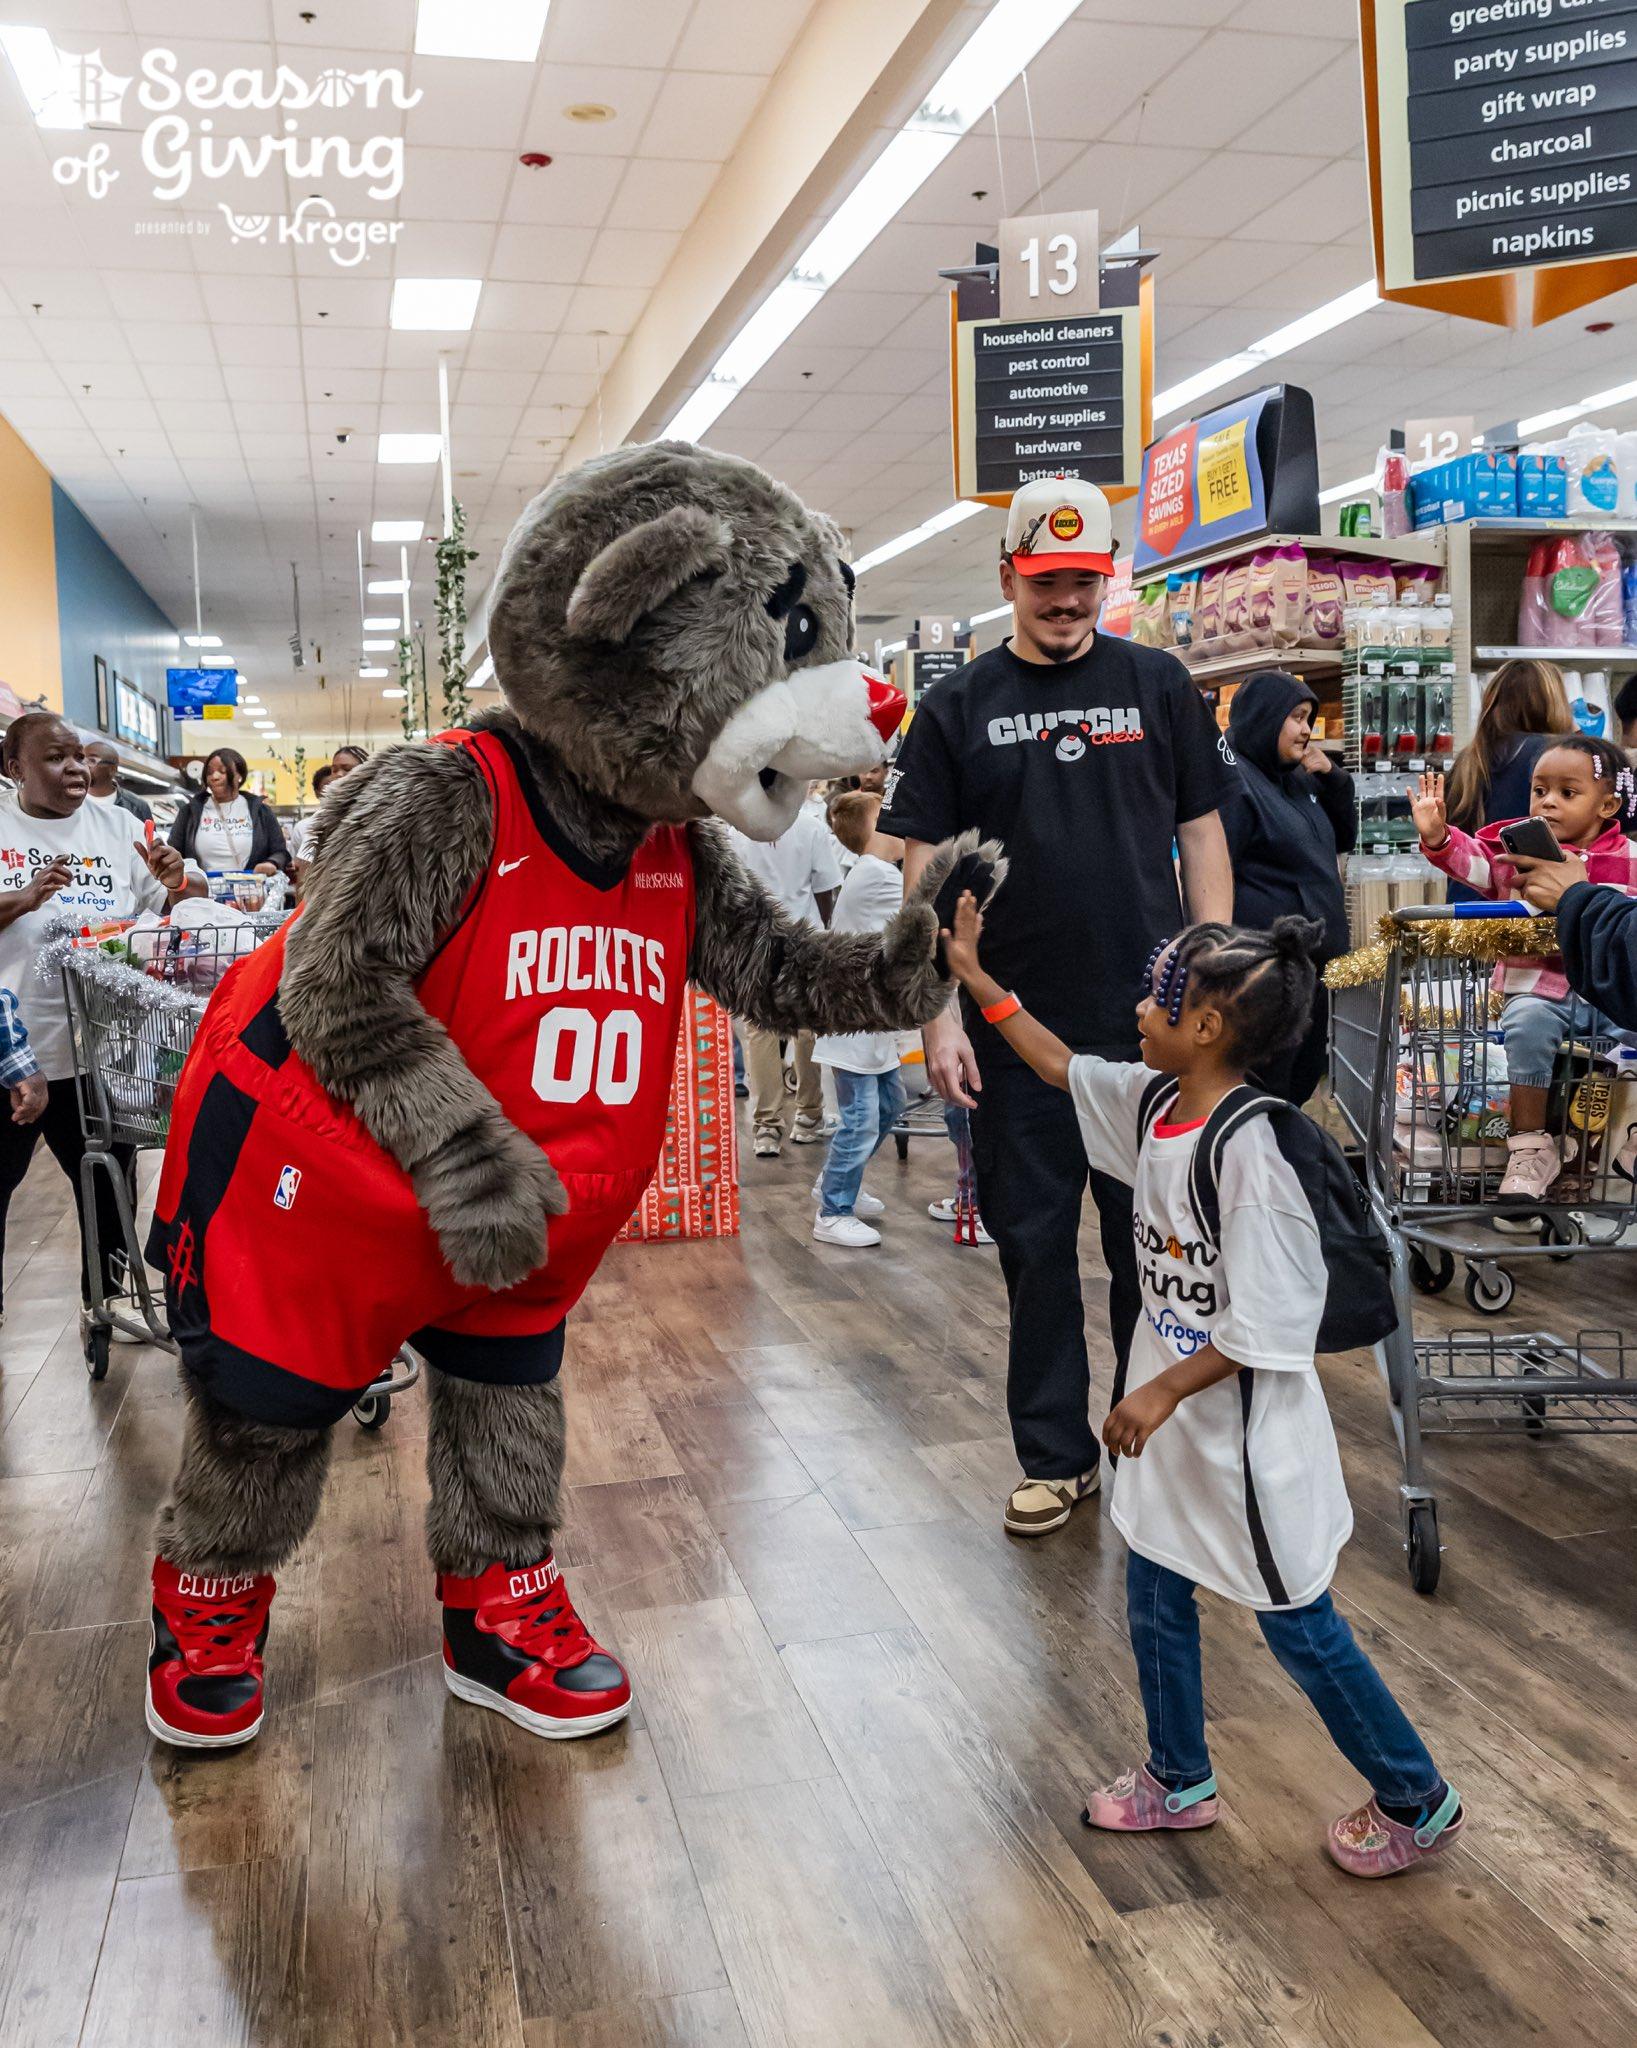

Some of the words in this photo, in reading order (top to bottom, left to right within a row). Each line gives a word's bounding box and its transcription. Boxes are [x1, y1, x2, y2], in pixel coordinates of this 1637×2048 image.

[1450, 0, 1551, 33] greeting
[1453, 47, 1518, 80] party
[1525, 29, 1627, 64] supplies
[1481, 91, 1526, 123] gift
[1531, 84, 1597, 107] wrap
[1490, 126, 1592, 162] charcoal
[1456, 185, 1524, 219] picnic
[1530, 171, 1631, 205] supplies
[1492, 224, 1594, 256] napkins
[1020, 234, 1078, 298] 13
[983, 328, 1054, 346] household
[1057, 324, 1114, 341] cleaners
[1008, 357, 1038, 375] pest
[1041, 352, 1090, 370] control
[1009, 382, 1088, 400] automotive
[994, 414, 1046, 429] laundry
[1049, 408, 1106, 427] supplies
[1015, 439, 1082, 455] hardware
[1153, 442, 1188, 478] TEXAS
[1419, 430, 1459, 462] 12
[1149, 468, 1185, 504] SIZED
[1209, 472, 1239, 502] FREE
[1148, 494, 1184, 524] SAVINGS
[931, 622, 943, 644] 9
[1092, 729, 1144, 746] CREW
[28, 848, 111, 869] Seson
[634, 872, 683, 881] MEMORIAL
[634, 880, 684, 889] HERMANN
[77, 891, 115, 912] Kroger
[505, 925, 666, 1005] ROCKETS
[530, 1006, 642, 1106] 00
[1590, 1083, 1611, 1119] Texas
[177, 1572, 255, 1598] CLUTCH
